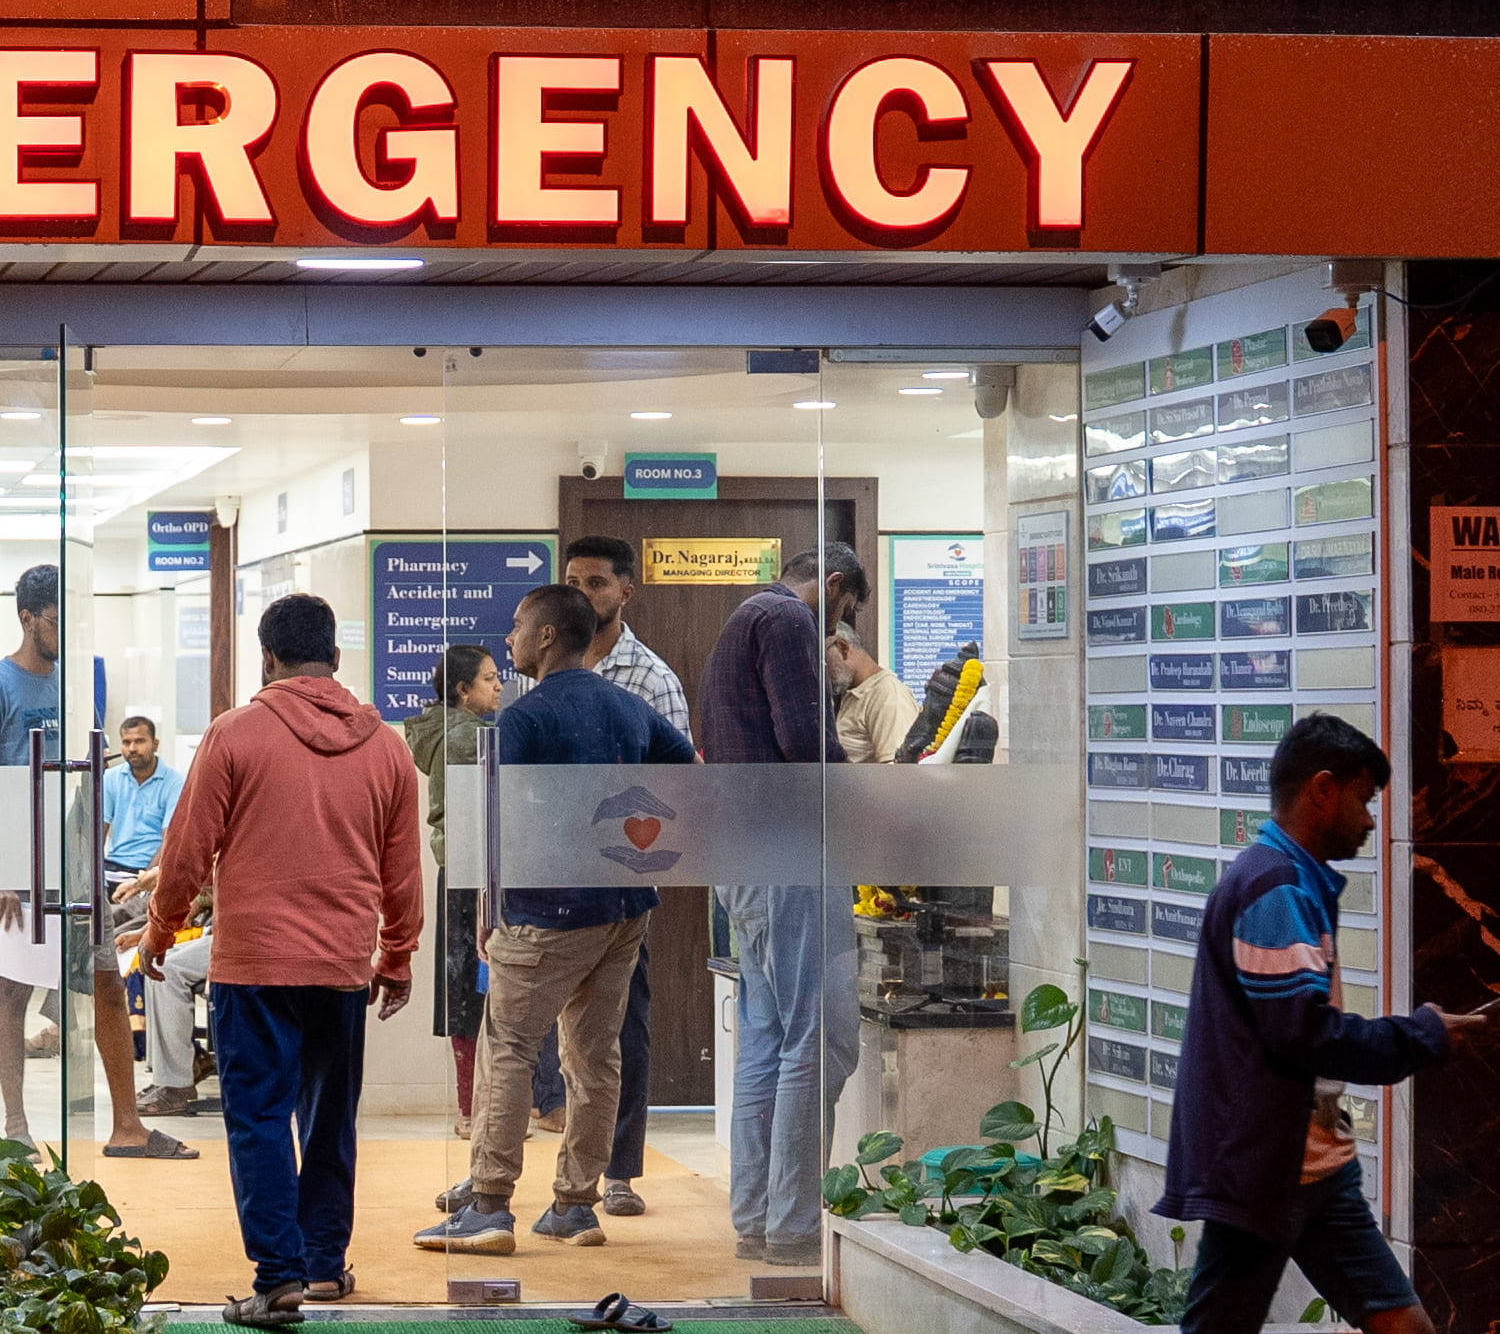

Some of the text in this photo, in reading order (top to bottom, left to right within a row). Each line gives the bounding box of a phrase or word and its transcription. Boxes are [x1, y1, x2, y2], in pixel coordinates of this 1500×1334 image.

[635, 468, 703, 480] ROOM NO.3
[151, 522, 209, 533] Ortho OPD
[154, 556, 205, 565] ROOM NO.2
[386, 557, 470, 575] Pharmacy
[652, 550, 675, 564] Dr.
[678, 550, 743, 567] Nagaraj,
[663, 569, 761, 577] MANAGING DIRECTOR
[1450, 564, 1485, 580] Male
[386, 584, 493, 600] Accident and
[1450, 589, 1486, 599] Contact
[386, 612, 478, 631] Emergency
[386, 639, 450, 654] Labora
[386, 666, 437, 684] Sampl
[1153, 710, 1164, 727] Dr.
[1242, 711, 1285, 739] Endoscopy
[1225, 760, 1240, 781] Dr.
[1118, 857, 1132, 873] ENT
